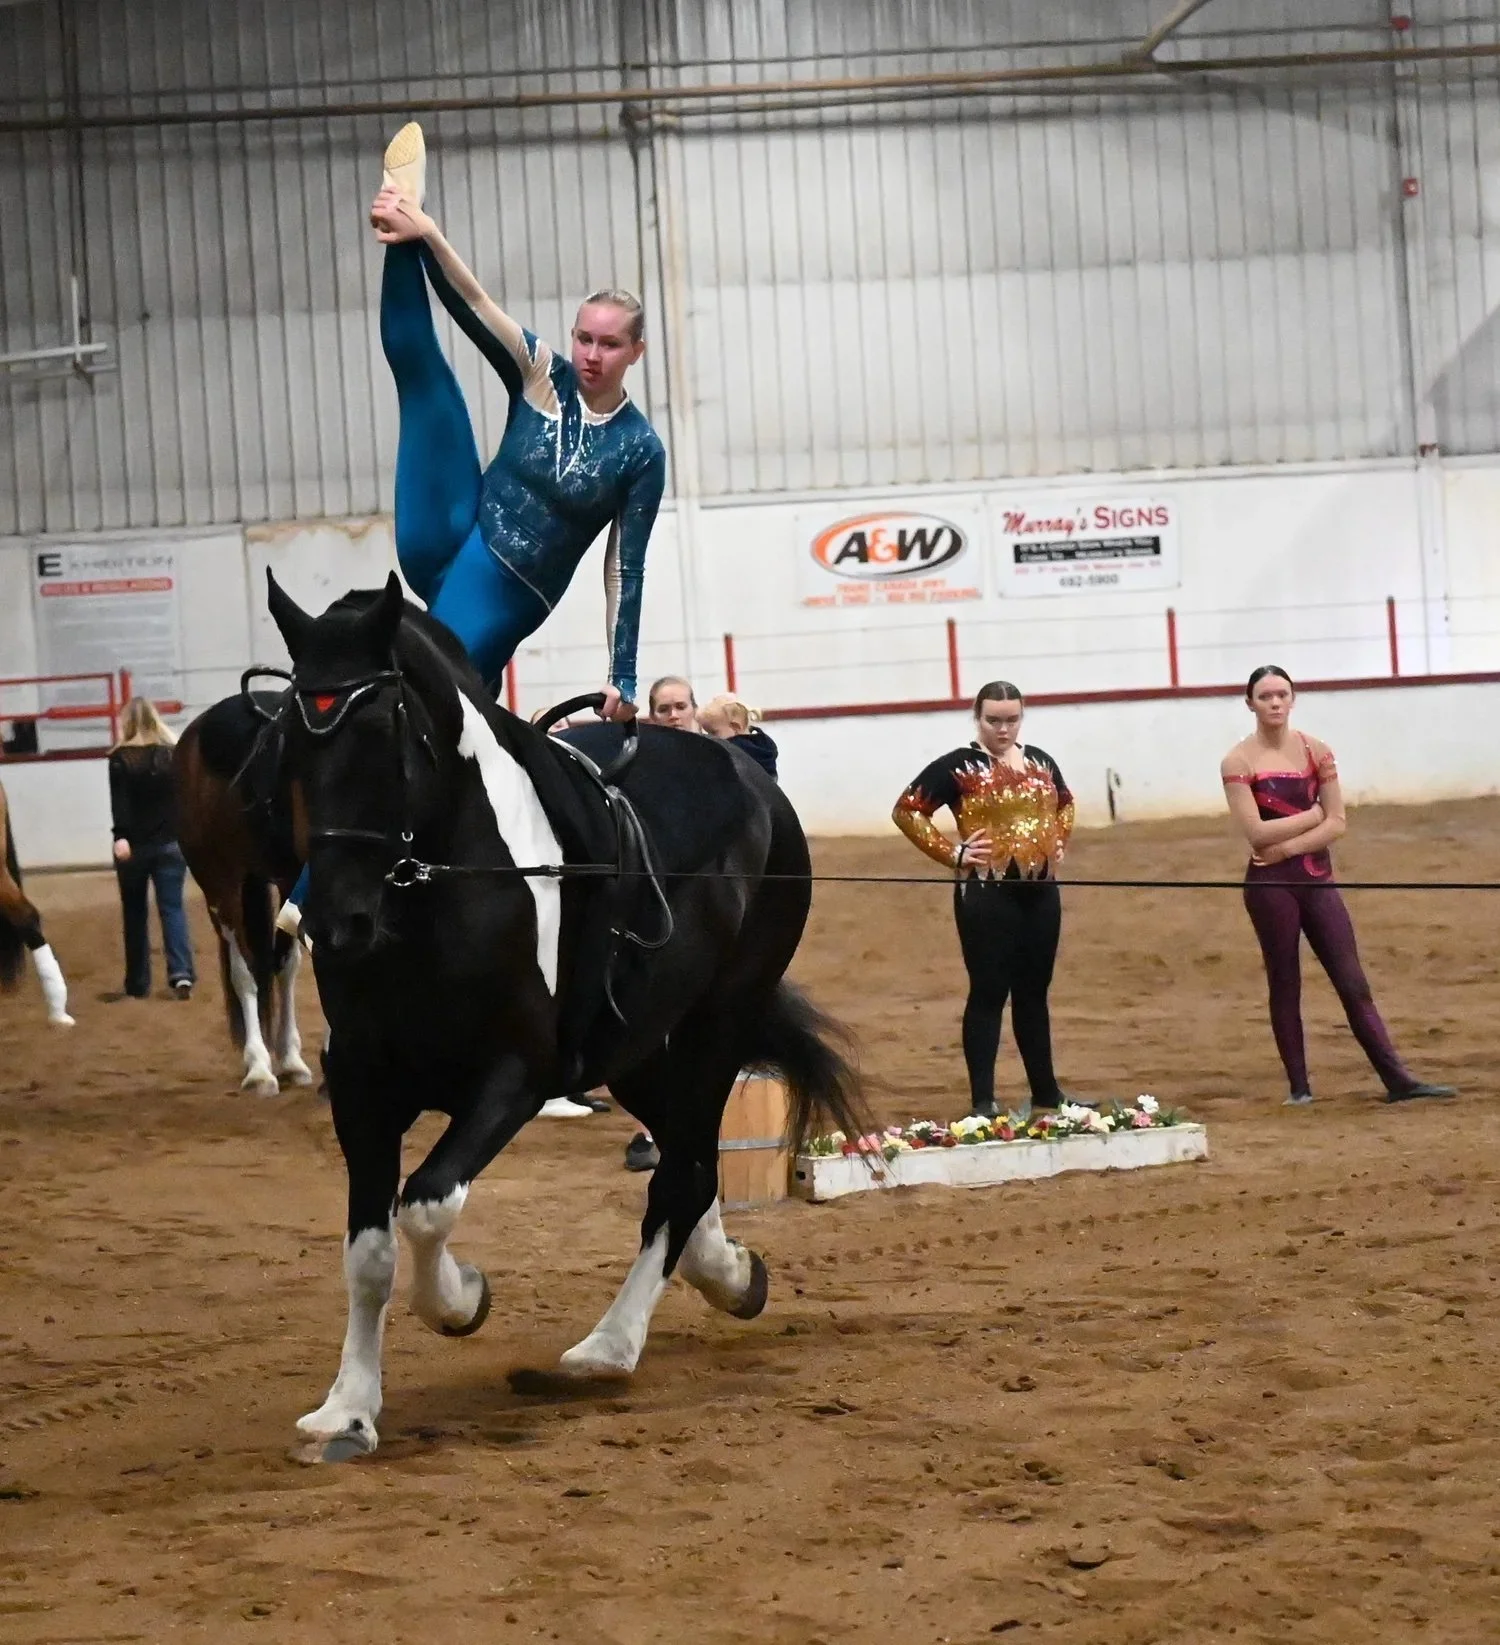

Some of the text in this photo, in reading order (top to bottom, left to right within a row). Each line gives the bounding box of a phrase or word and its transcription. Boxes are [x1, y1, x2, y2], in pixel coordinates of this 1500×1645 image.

[1002, 506, 1169, 537] Murray's SIGNS
[834, 526, 948, 564] A&W
